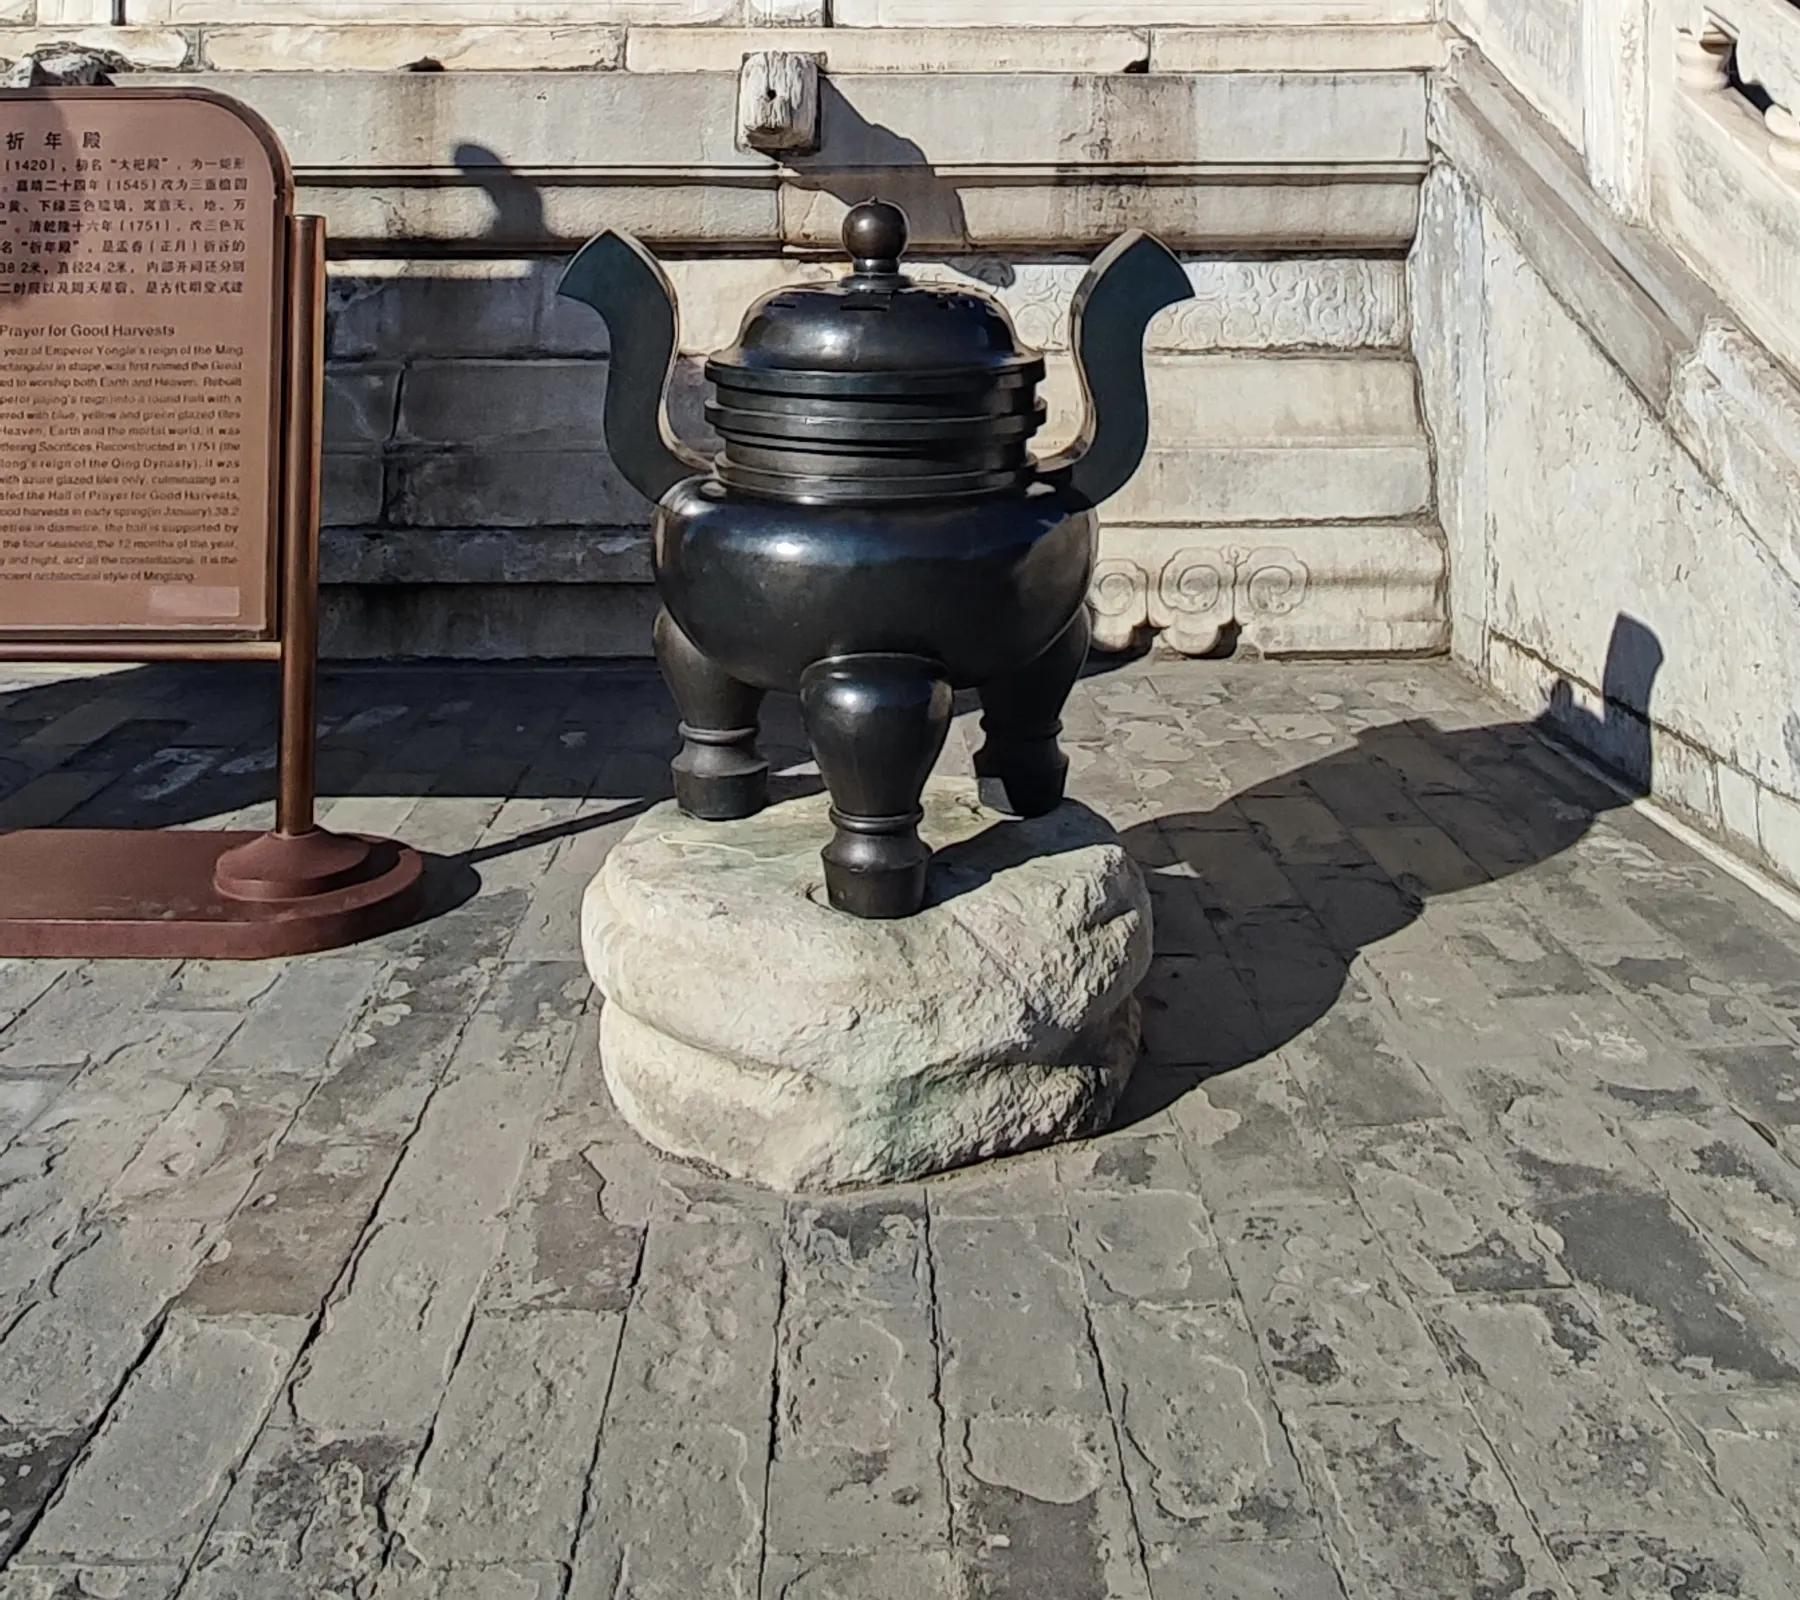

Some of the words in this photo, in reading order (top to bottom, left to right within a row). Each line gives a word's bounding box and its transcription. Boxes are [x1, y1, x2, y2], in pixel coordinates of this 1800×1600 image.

[0, 324, 45, 339] Prayer
[49, 324, 66, 336] for
[71, 324, 109, 336] Good
[112, 324, 175, 336] Harvests
[30, 345, 42, 355] of
[45, 345, 93, 357] Emperor
[194, 345, 212, 354] the
[215, 344, 244, 357] Ming
[191, 362, 209, 371] the
[16, 378, 27, 387] to
[73, 378, 98, 387] both
[132, 378, 153, 386] and
[119, 410, 141, 419] and
[83, 426, 105, 435] and
[107, 426, 126, 435] the
[40, 458, 72, 471] reign
[74, 457, 86, 469] of
[89, 457, 109, 469] the
[26, 490, 45, 500] the
[73, 490, 86, 500] of
[88, 490, 128, 502] Prayer
[150, 489, 182, 500] Good
[105, 523, 124, 532] the
[224, 523, 239, 533] by
[3, 539, 20, 548] the
[177, 539, 188, 548] of
[131, 570, 141, 580] of
